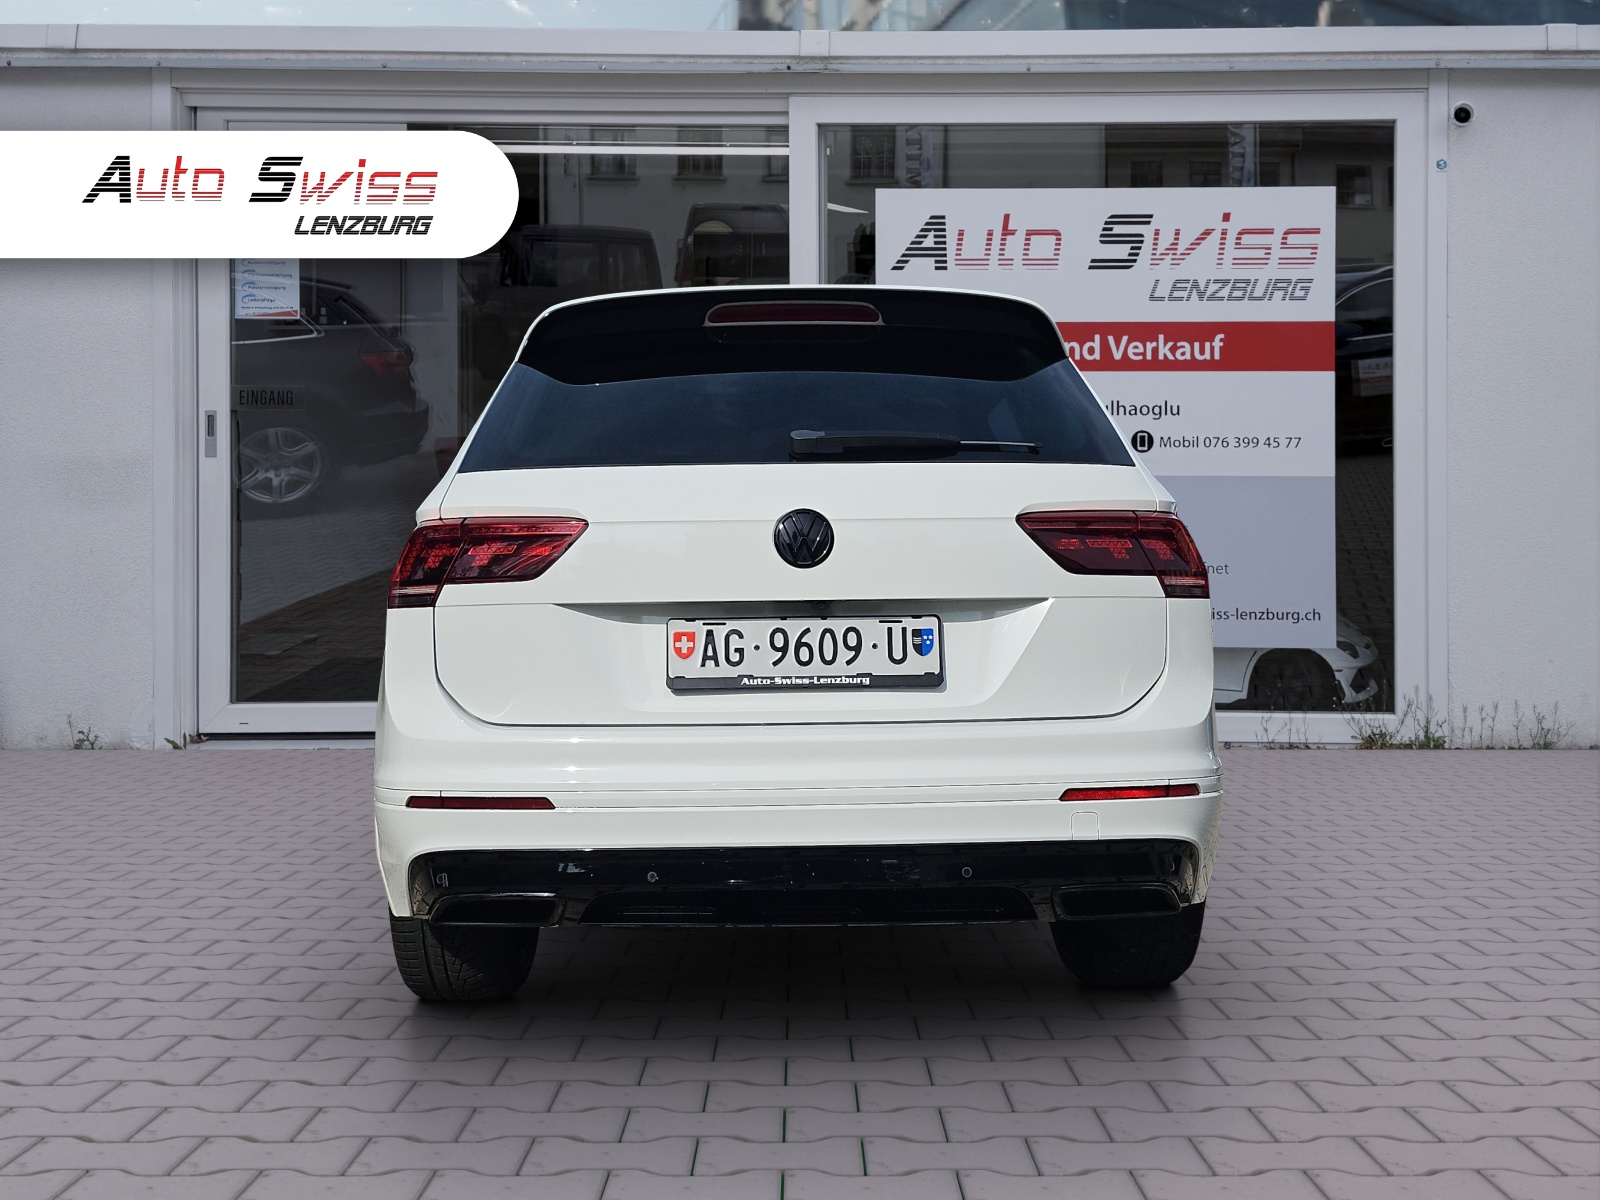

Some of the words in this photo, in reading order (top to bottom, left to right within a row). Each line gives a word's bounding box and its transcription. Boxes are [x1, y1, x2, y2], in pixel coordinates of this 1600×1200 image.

[890, 213, 1063, 270] Auto
[1088, 212, 1321, 270] Swiss
[1148, 278, 1314, 302] LENZBURG
[1064, 334, 1100, 361] nd
[1107, 334, 1225, 361] Verkauf
[239, 389, 294, 406] EINGANG
[1105, 400, 1181, 420] lhaoglu
[1159, 436, 1199, 448] Mobil
[1203, 436, 1230, 448] 076
[1233, 436, 1260, 448] 399
[1263, 436, 1281, 448] 45
[1285, 436, 1302, 448] 77
[1203, 561, 1230, 574] net
[1211, 608, 1322, 624] iss-lenzburg.ch
[741, 676, 870, 685] Auto-Swiss-Lenzburg
